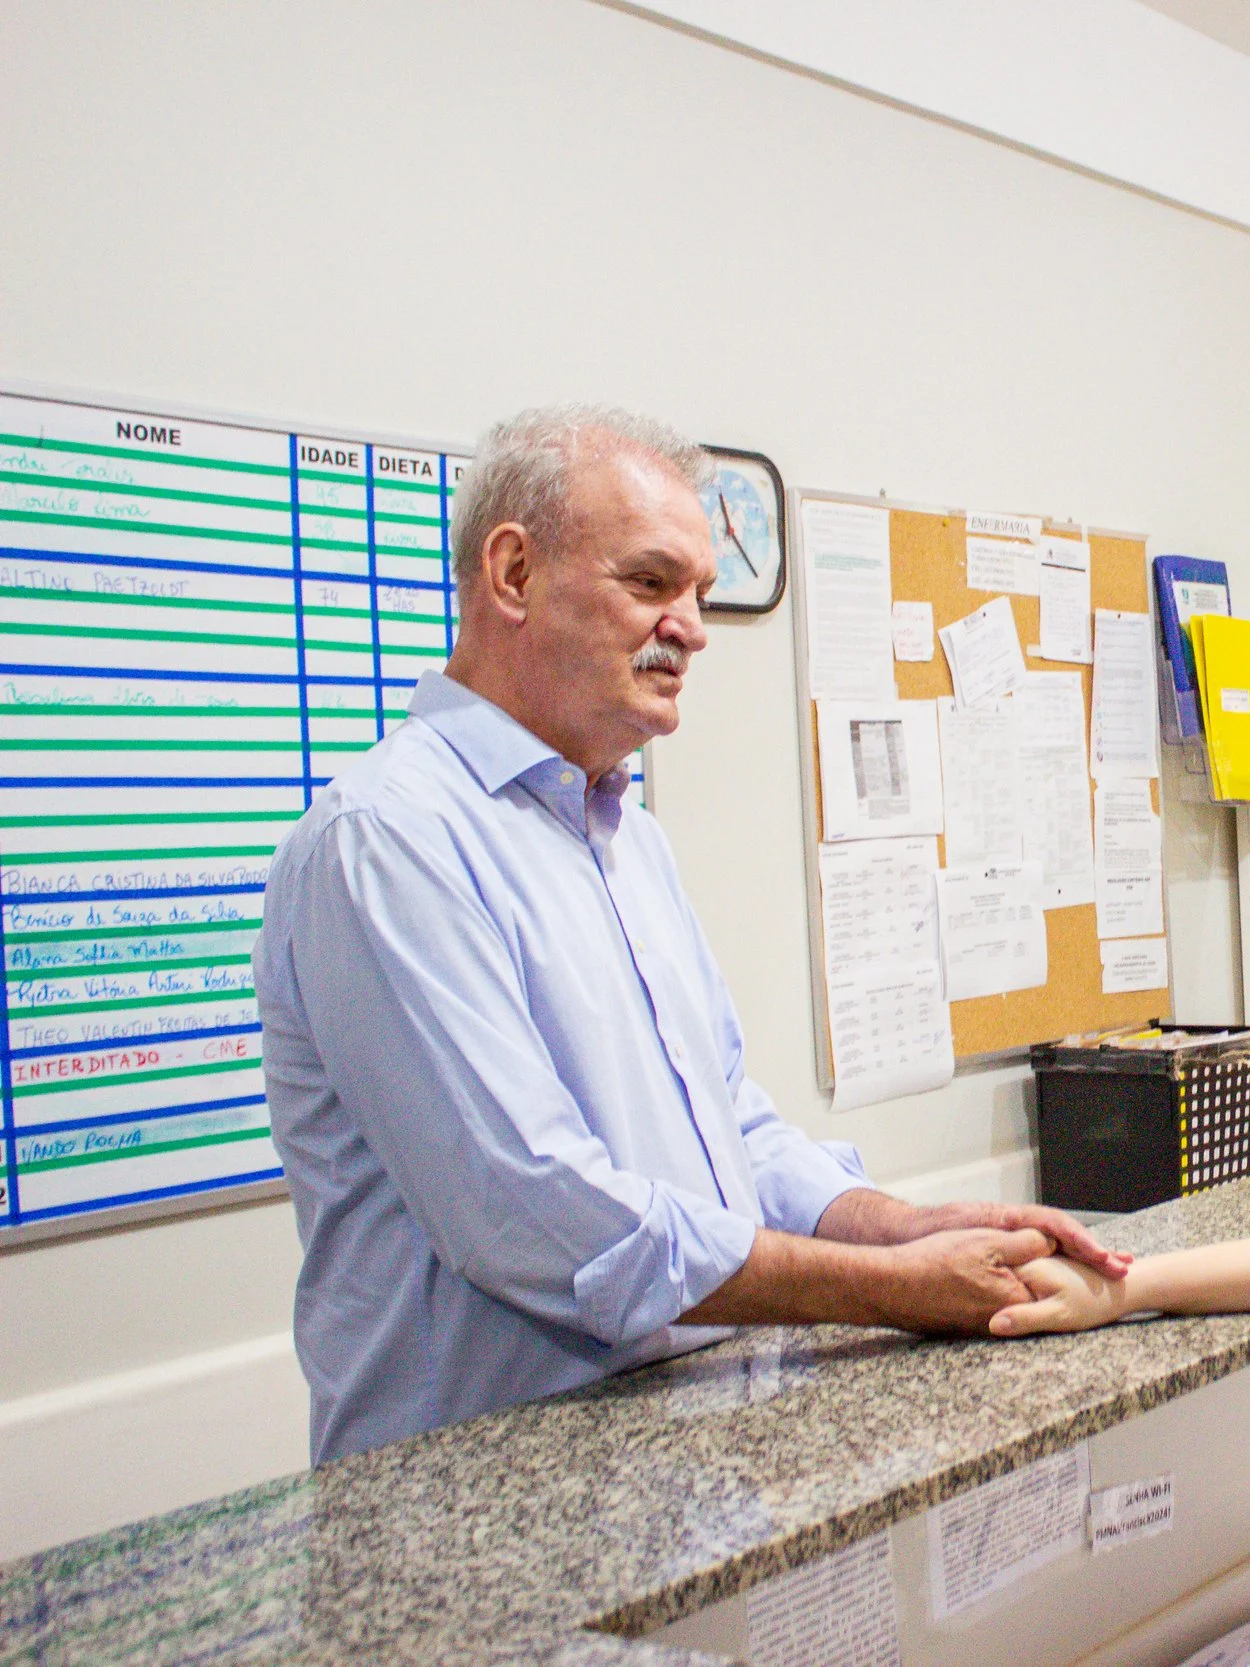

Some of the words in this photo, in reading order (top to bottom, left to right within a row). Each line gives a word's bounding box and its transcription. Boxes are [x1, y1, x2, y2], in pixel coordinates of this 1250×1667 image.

[116, 421, 182, 446] NOME
[301, 445, 360, 468] IDADE
[378, 456, 434, 477] DIETA
[13, 1050, 160, 1082] INTERDITADO
[203, 1037, 249, 1060] CME
